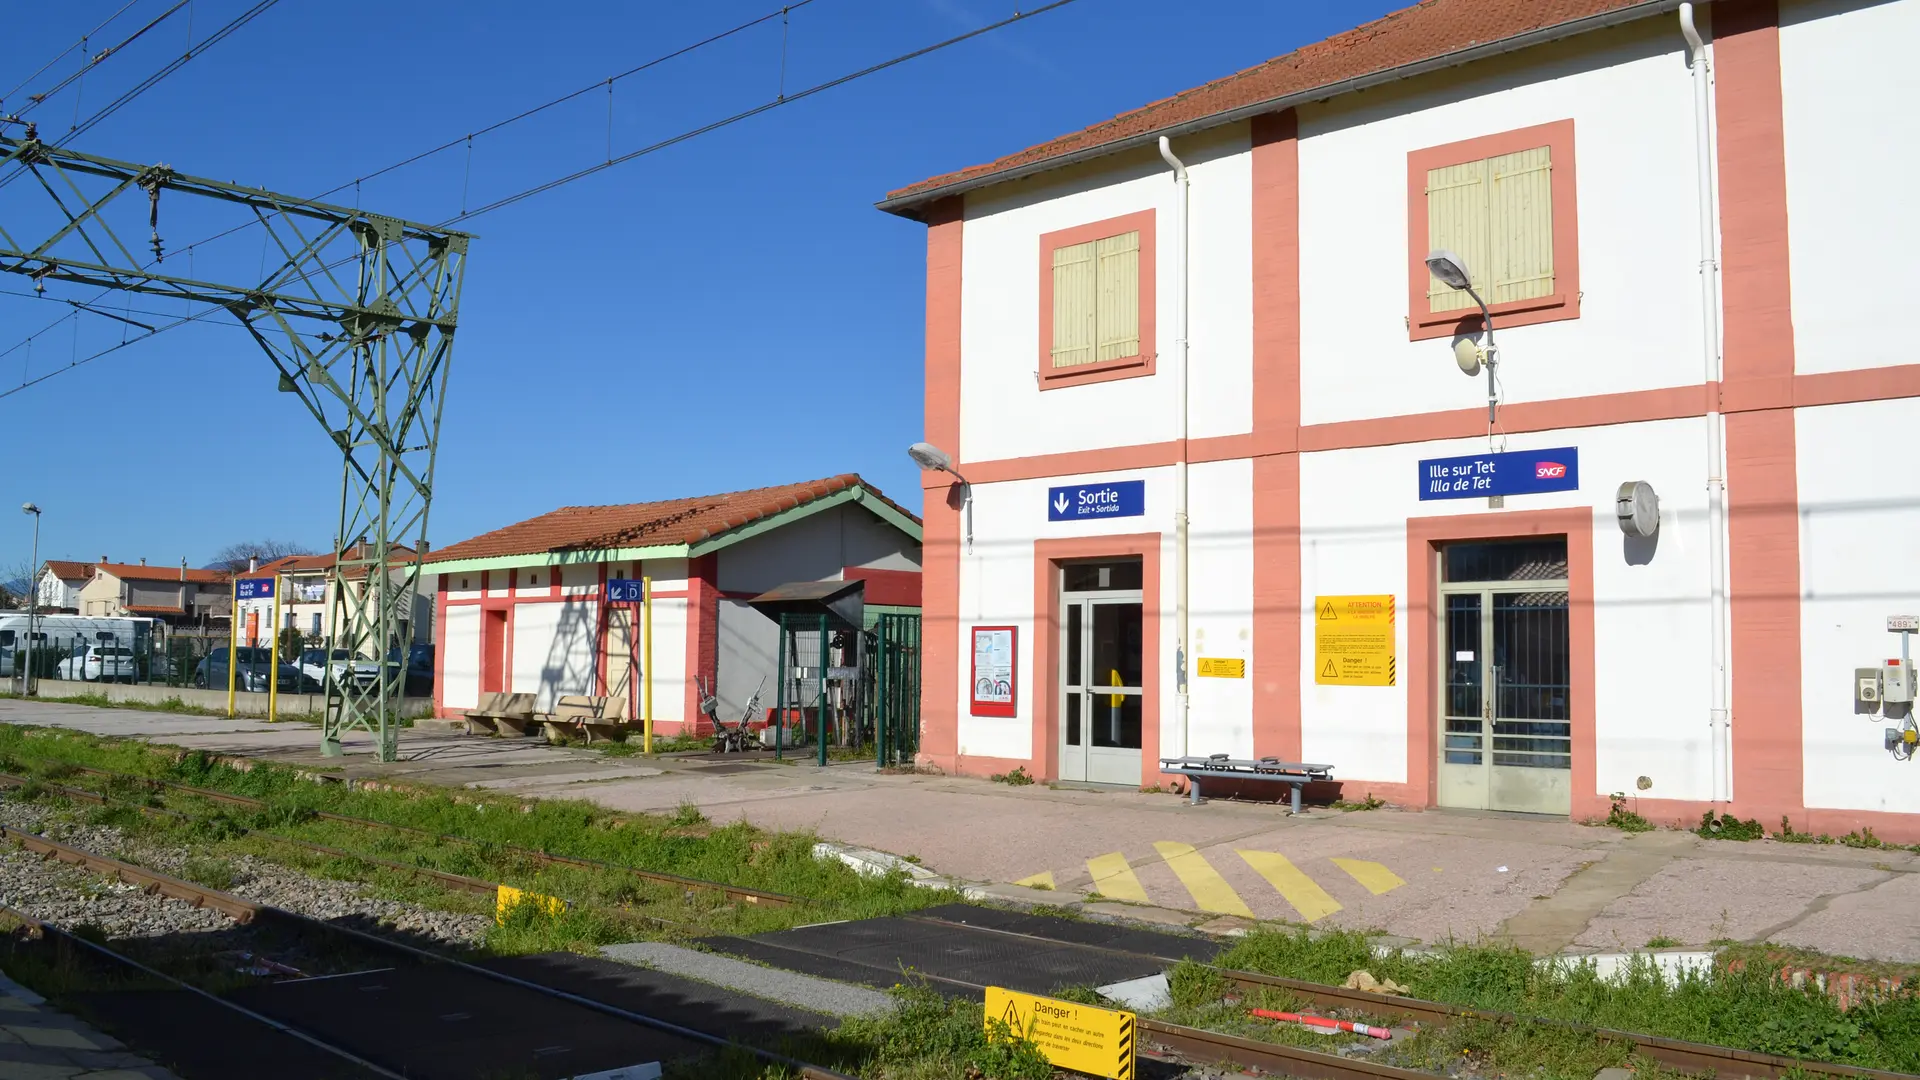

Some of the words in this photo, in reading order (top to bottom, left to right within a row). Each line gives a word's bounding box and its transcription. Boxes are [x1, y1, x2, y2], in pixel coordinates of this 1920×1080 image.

[1430, 465, 1448, 478] Ille
[1452, 465, 1472, 476] sur
[1475, 462, 1495, 474] Tet
[1536, 466, 1564, 477] SNCF
[1430, 480, 1450, 492] Illa
[1454, 478, 1468, 490] de
[1473, 476, 1491, 489] Tet
[1078, 488, 1118, 505] Sortie
[1078, 506, 1090, 514] Exit
[1096, 504, 1120, 513] Sortida
[630, 588, 638, 598] D
[1034, 1002, 1070, 1018] Danger
[1075, 1010, 1078, 1020] !
[1083, 1040, 1103, 1049] directions
